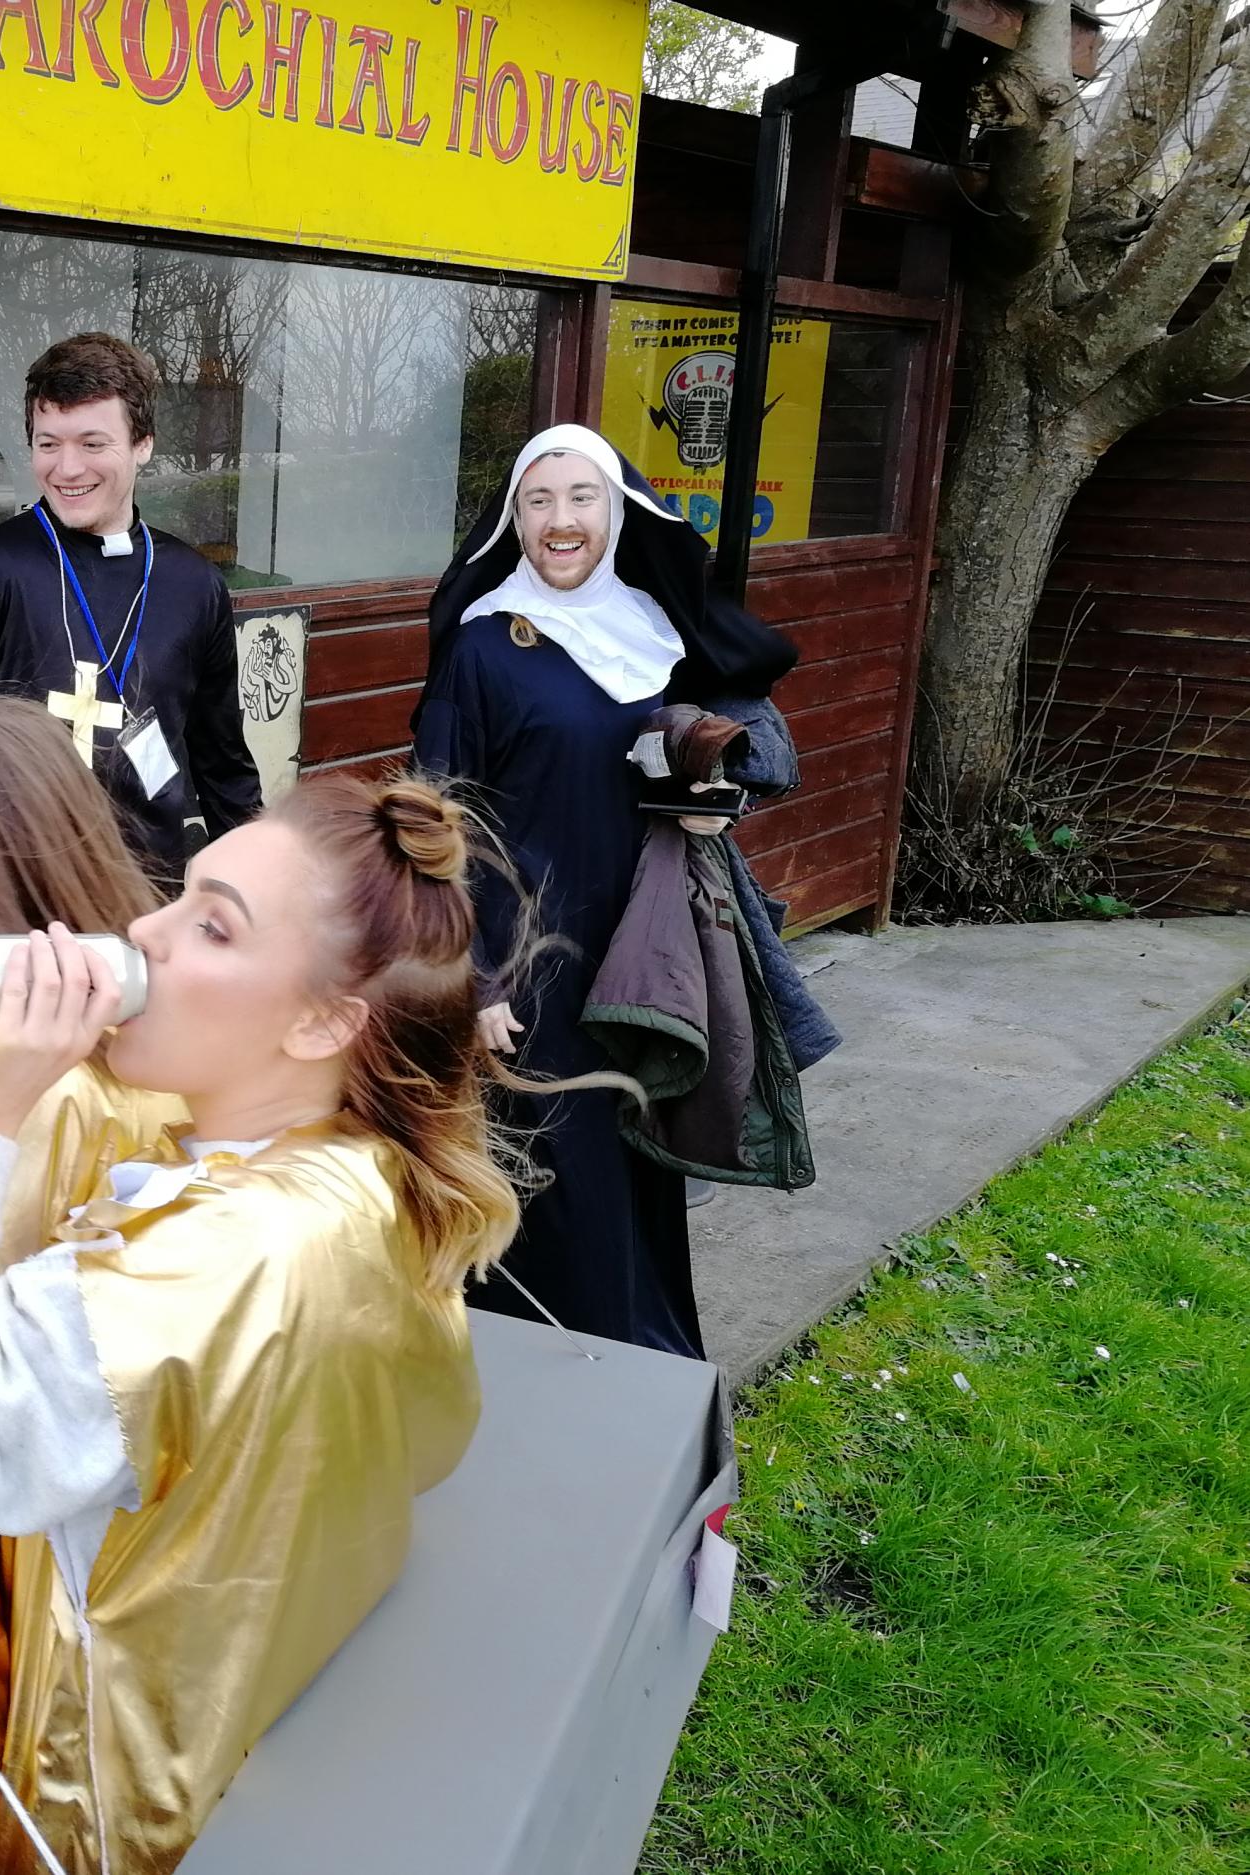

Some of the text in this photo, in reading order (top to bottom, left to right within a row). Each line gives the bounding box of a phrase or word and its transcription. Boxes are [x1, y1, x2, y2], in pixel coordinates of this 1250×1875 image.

[446, 5, 634, 187] HOUSE
[673, 319, 688, 330] IT
[690, 317, 735, 329] COMES
[660, 335, 669, 348] A
[672, 333, 728, 348] MATTER
[728, 332, 739, 345] O
